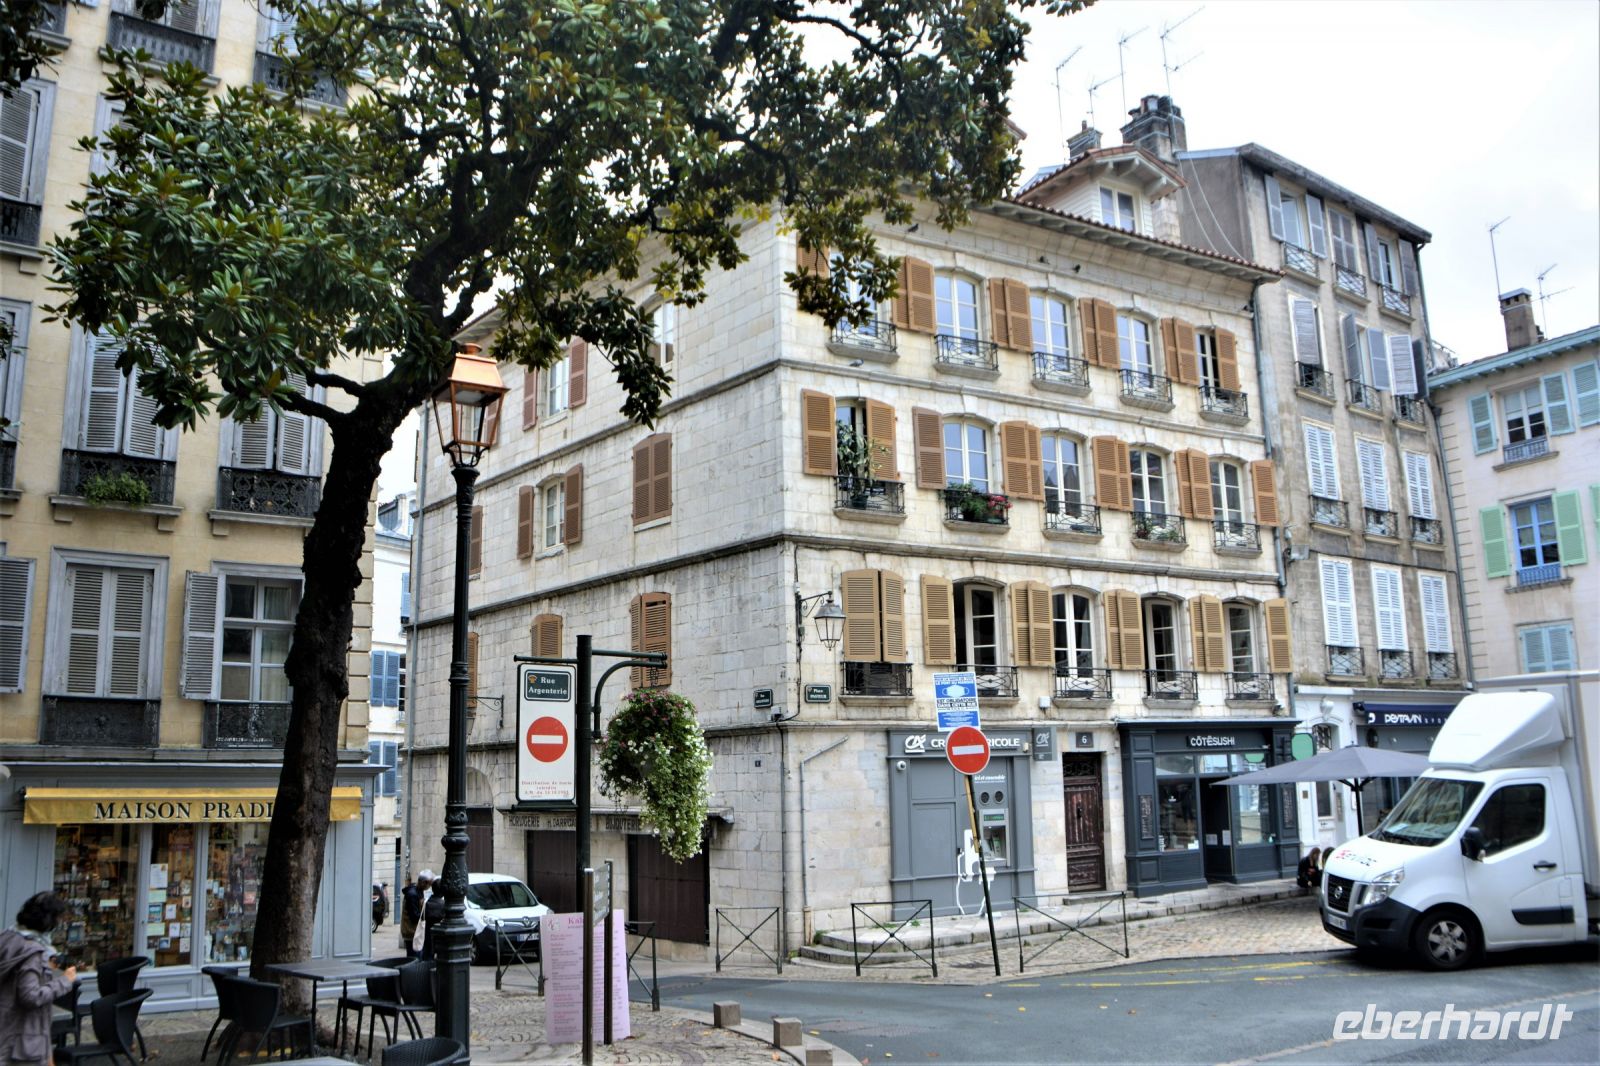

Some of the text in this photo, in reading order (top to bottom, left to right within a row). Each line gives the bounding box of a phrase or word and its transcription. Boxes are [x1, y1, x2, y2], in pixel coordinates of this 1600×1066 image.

[541, 676, 555, 684] Rue
[528, 686, 568, 695] Argenterie
[987, 738, 1021, 747] RICOLE
[1081, 735, 1088, 744] 6
[95, 802, 274, 820] MAISON PRADI
